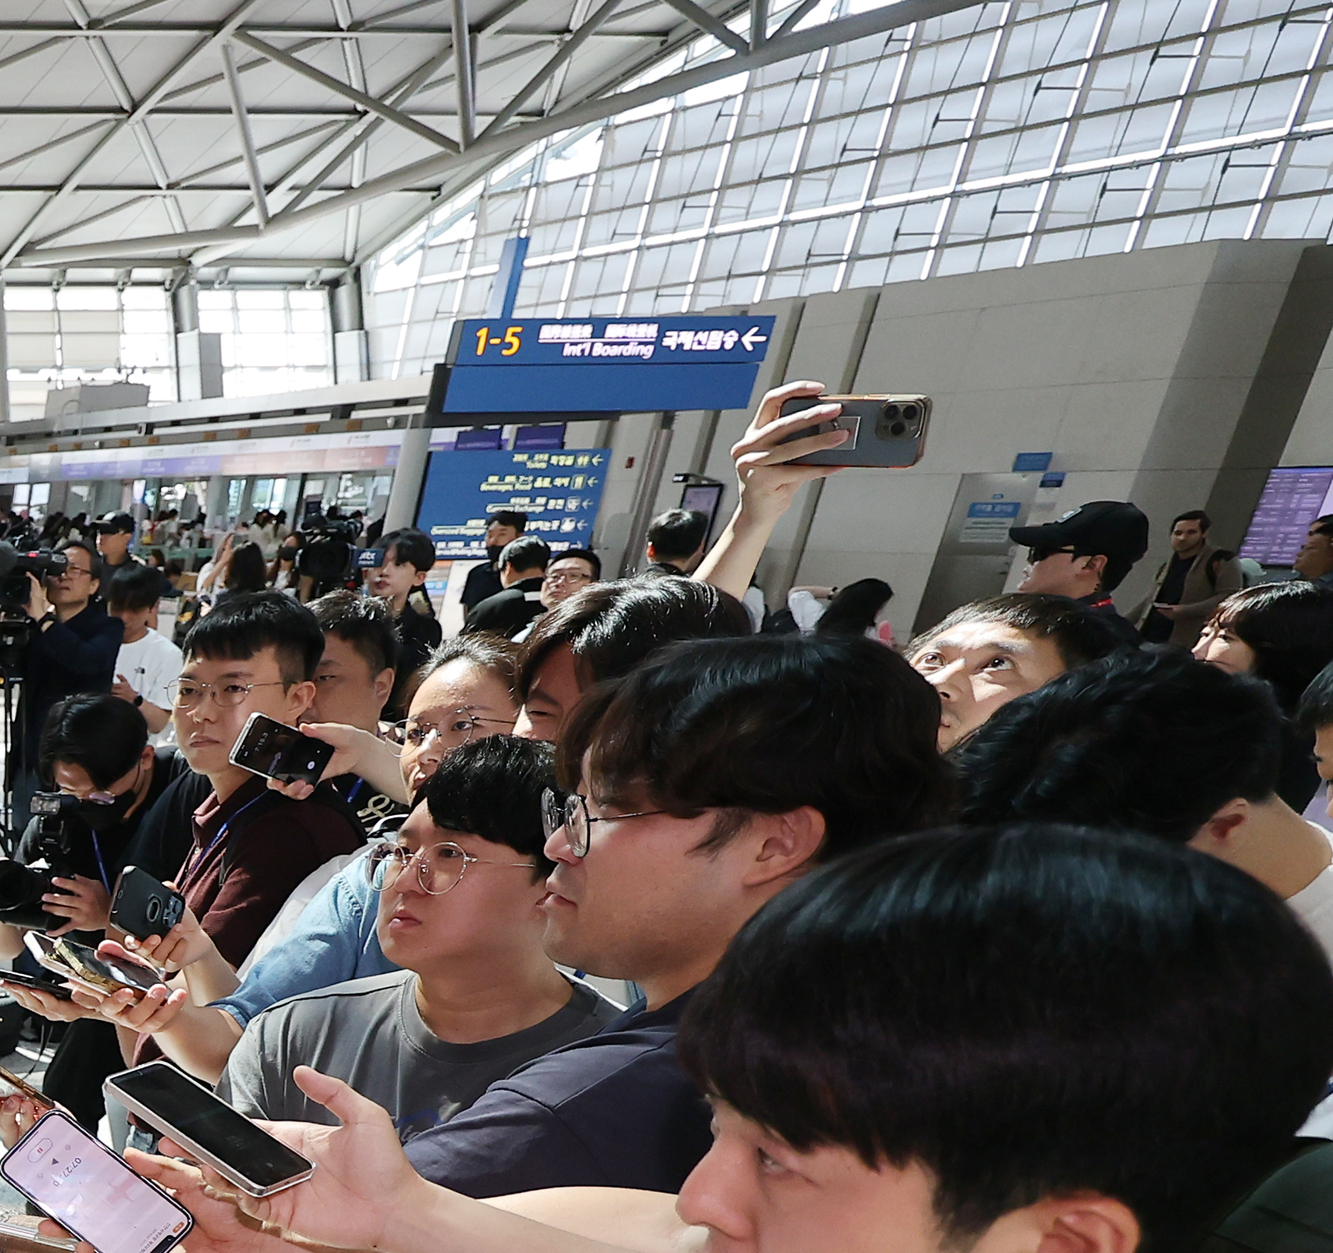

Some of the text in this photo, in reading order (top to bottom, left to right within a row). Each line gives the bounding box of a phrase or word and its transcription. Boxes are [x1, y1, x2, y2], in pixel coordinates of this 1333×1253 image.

[474, 326, 525, 356] 1-5
[562, 342, 655, 360] Int'l Boarding
